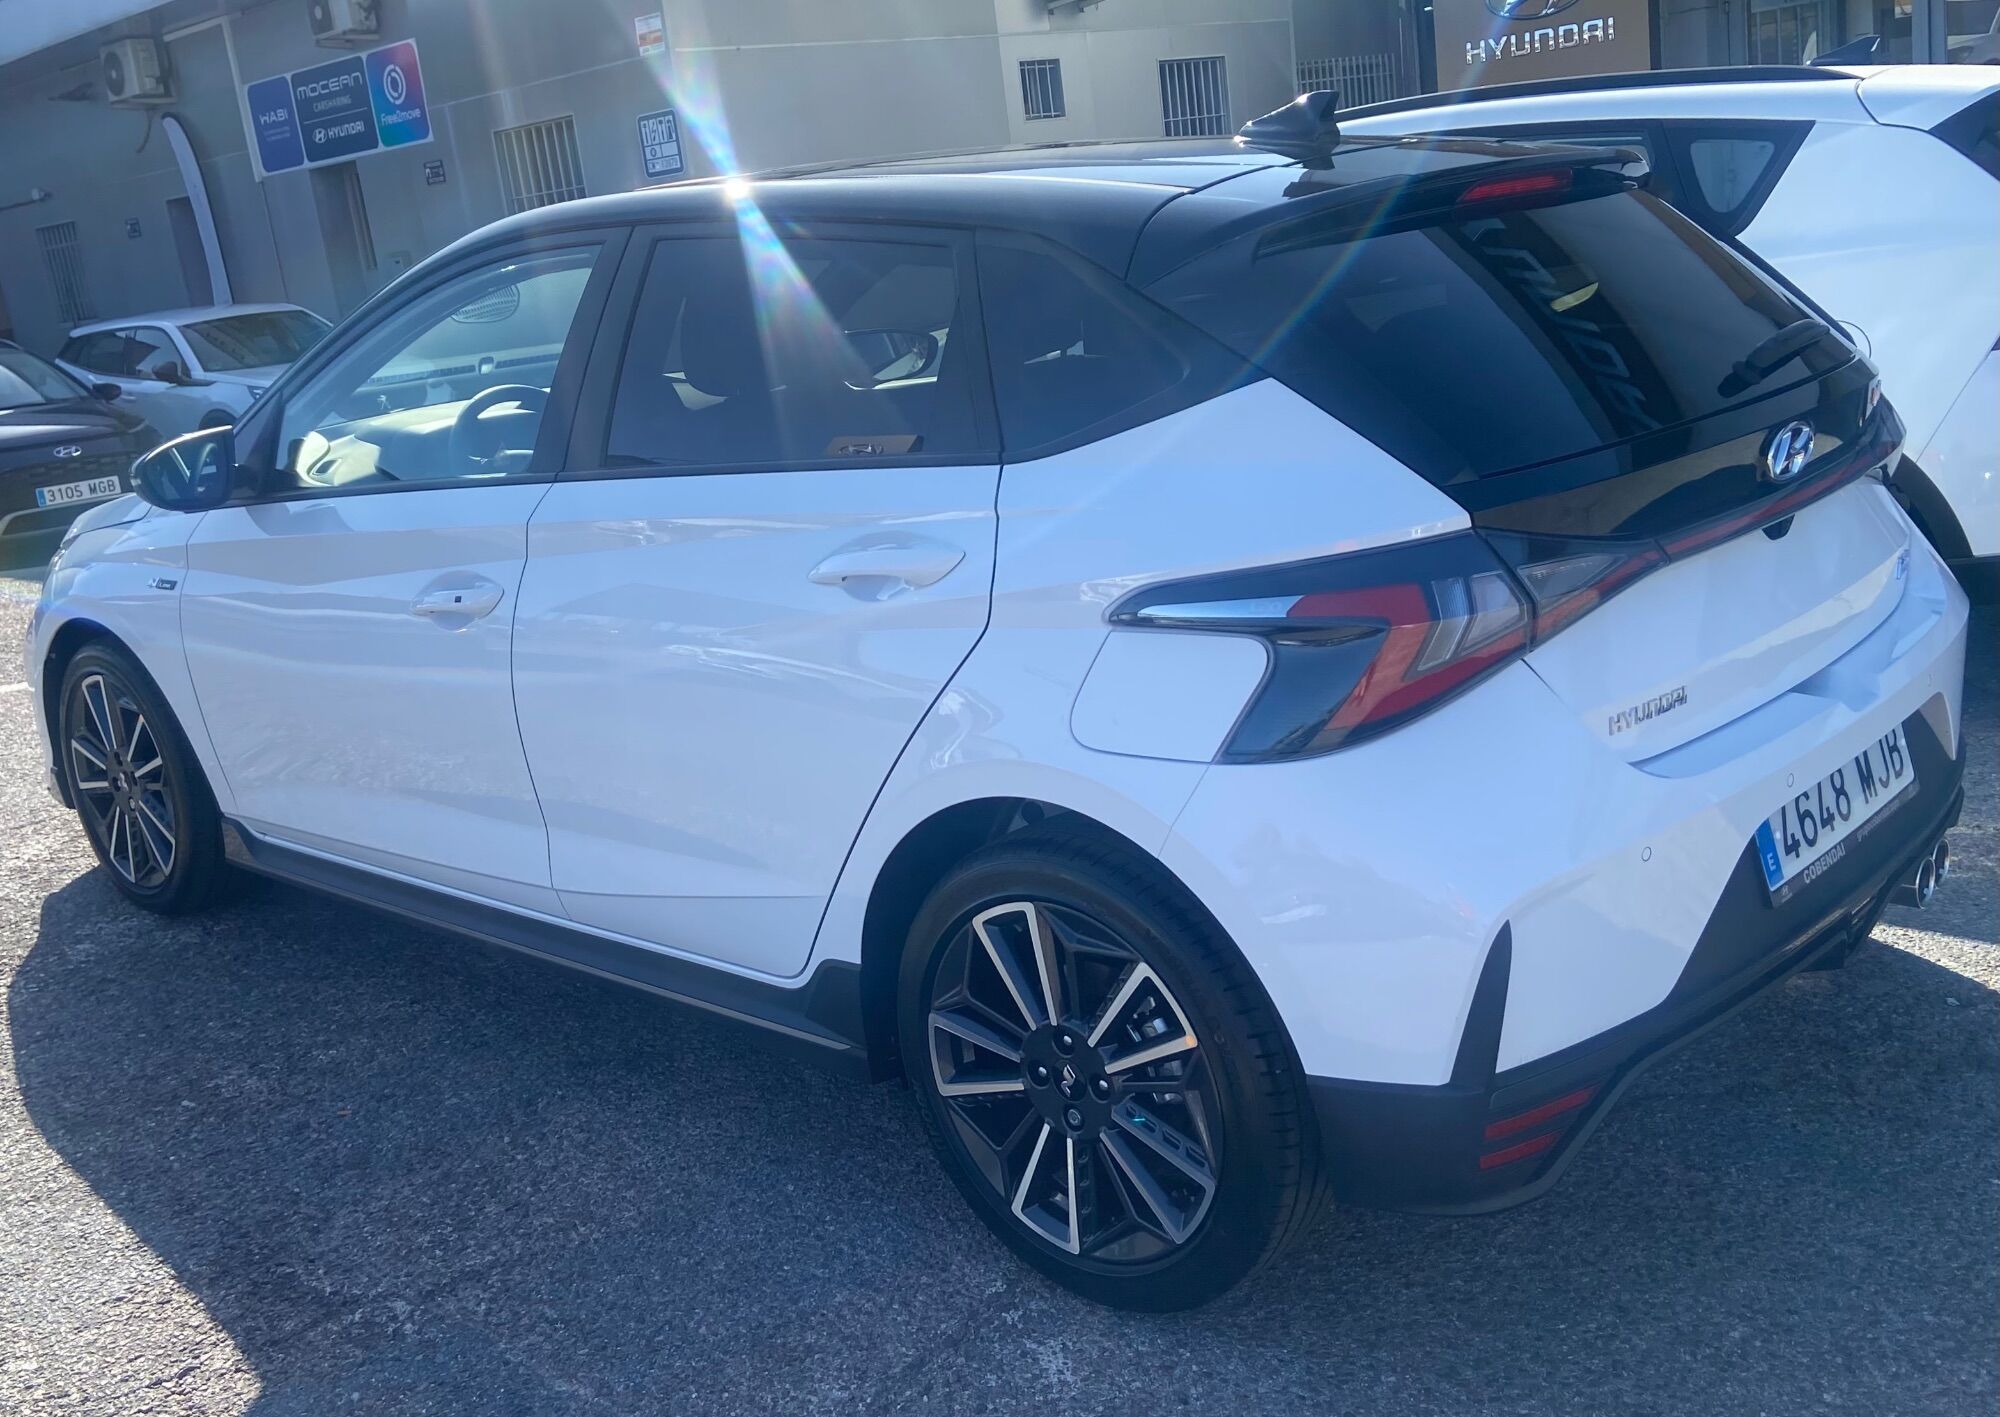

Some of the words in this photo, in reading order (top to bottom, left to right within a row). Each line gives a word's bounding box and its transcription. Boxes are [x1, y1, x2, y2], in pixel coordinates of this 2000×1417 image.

[1465, 16, 1615, 65] HYUNDAI
[296, 71, 363, 100] MOCEAN
[259, 108, 289, 125] WABI
[327, 120, 365, 140] HYUNDAI
[47, 484, 83, 503] 3105
[88, 479, 116, 496] MGB
[1608, 685, 1688, 737] HYUNDAI
[1780, 767, 1852, 859] 4648
[1854, 728, 1904, 805] MJB
[1766, 852, 1777, 872] E
[1803, 842, 1846, 885] COBENDAI
